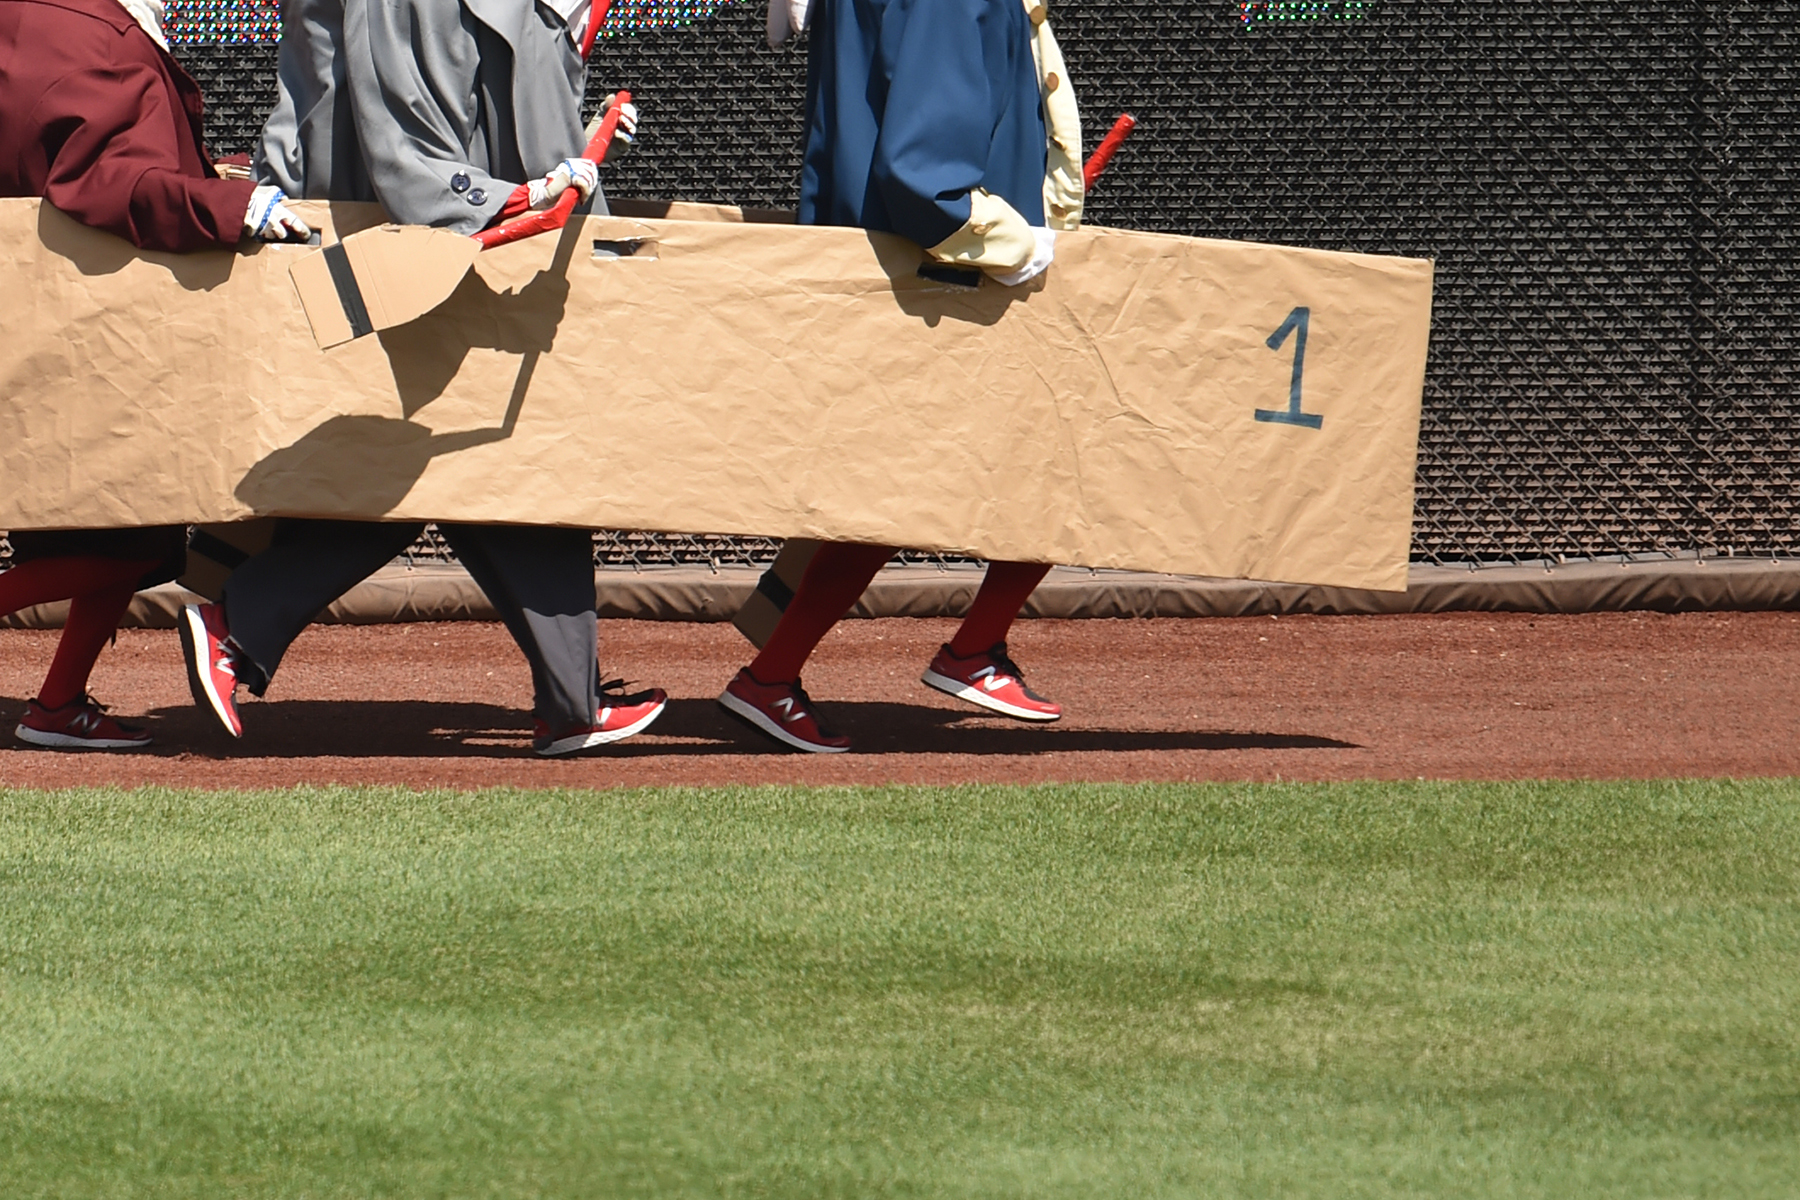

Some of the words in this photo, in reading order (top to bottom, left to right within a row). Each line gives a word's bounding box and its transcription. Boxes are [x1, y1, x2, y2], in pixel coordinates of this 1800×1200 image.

[1254, 306, 1324, 430] 1
[970, 665, 1011, 691] N
[768, 697, 806, 721] N
